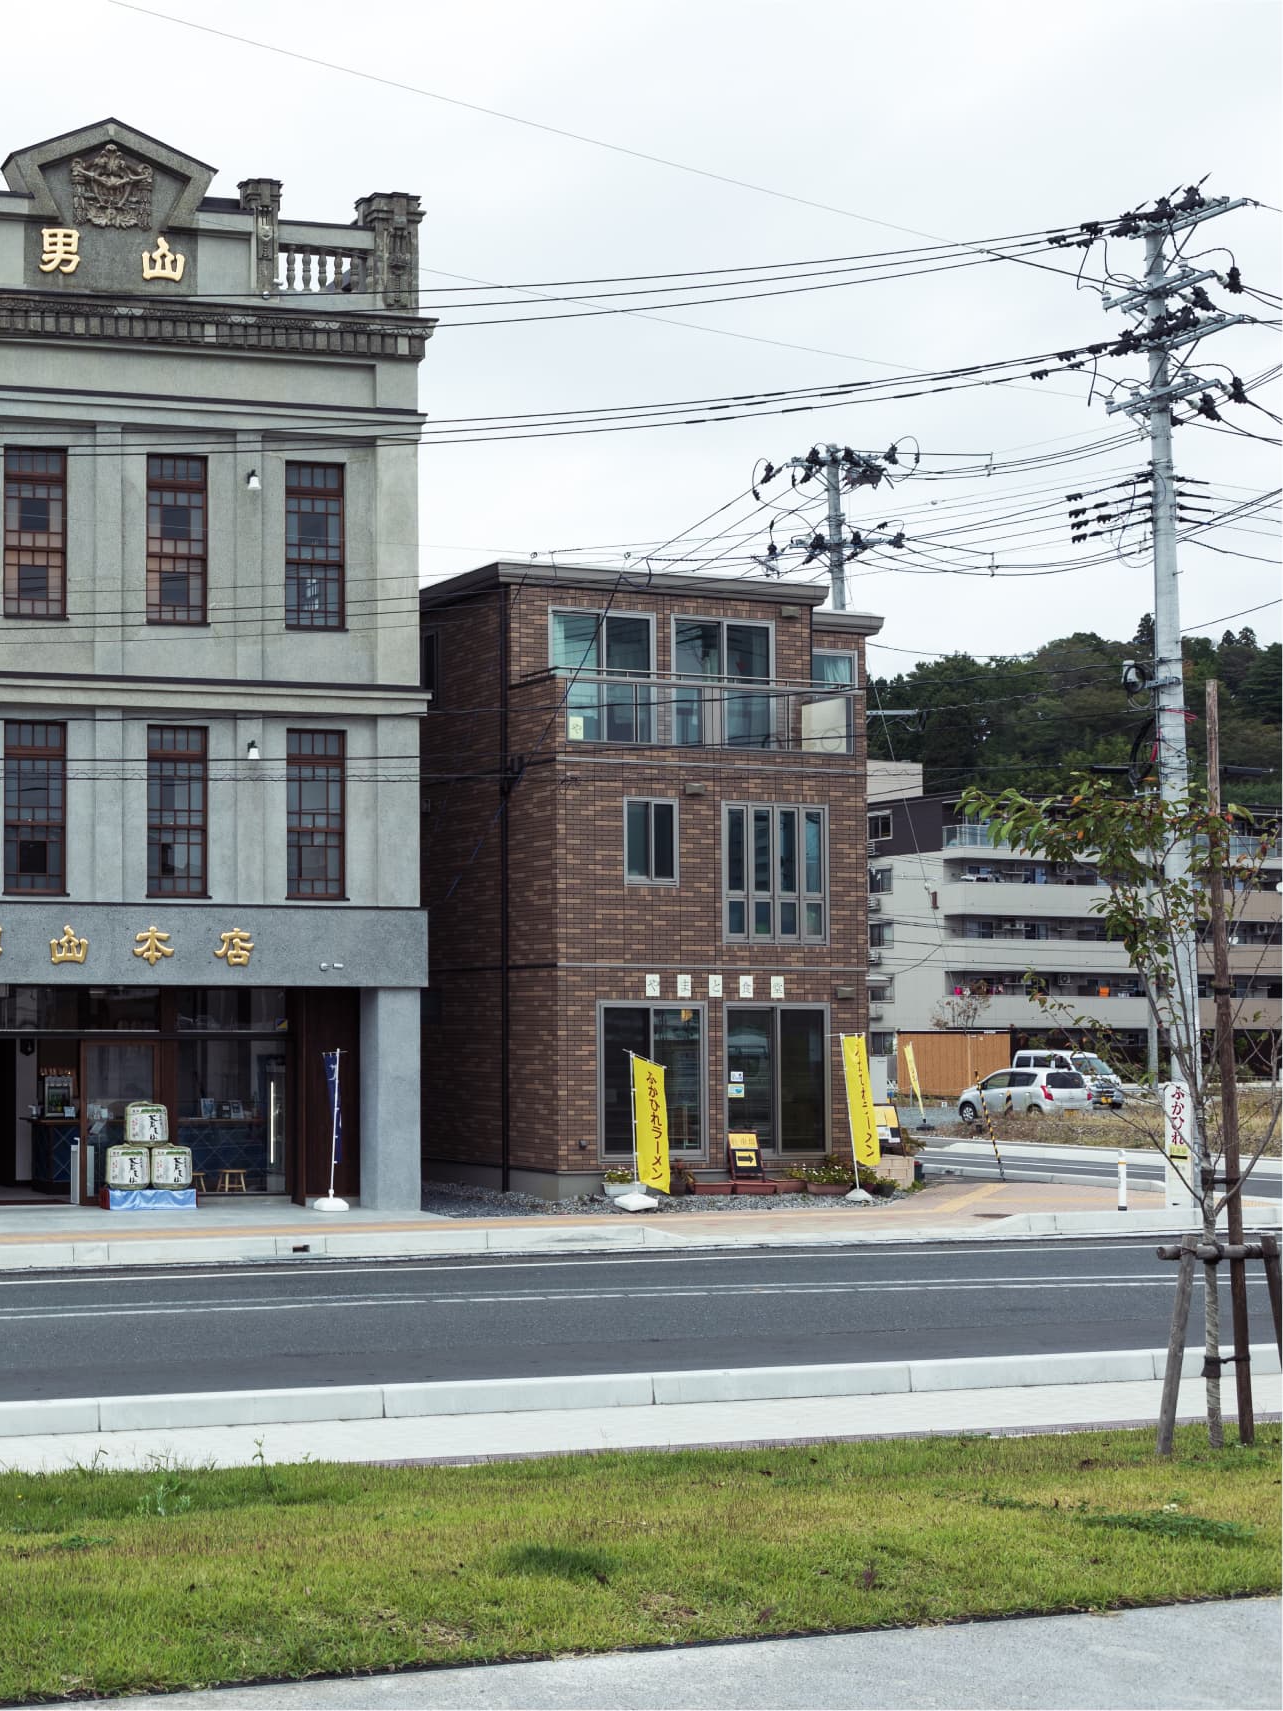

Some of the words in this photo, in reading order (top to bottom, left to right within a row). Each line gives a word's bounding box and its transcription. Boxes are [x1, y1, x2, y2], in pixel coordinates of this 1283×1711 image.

[39, 228, 185, 282] 男山
[647, 979, 783, 994] やまと食堂
[646, 1071, 663, 1180] ふかひれラーメン
[1171, 1086, 1185, 1145] ふかひれ
